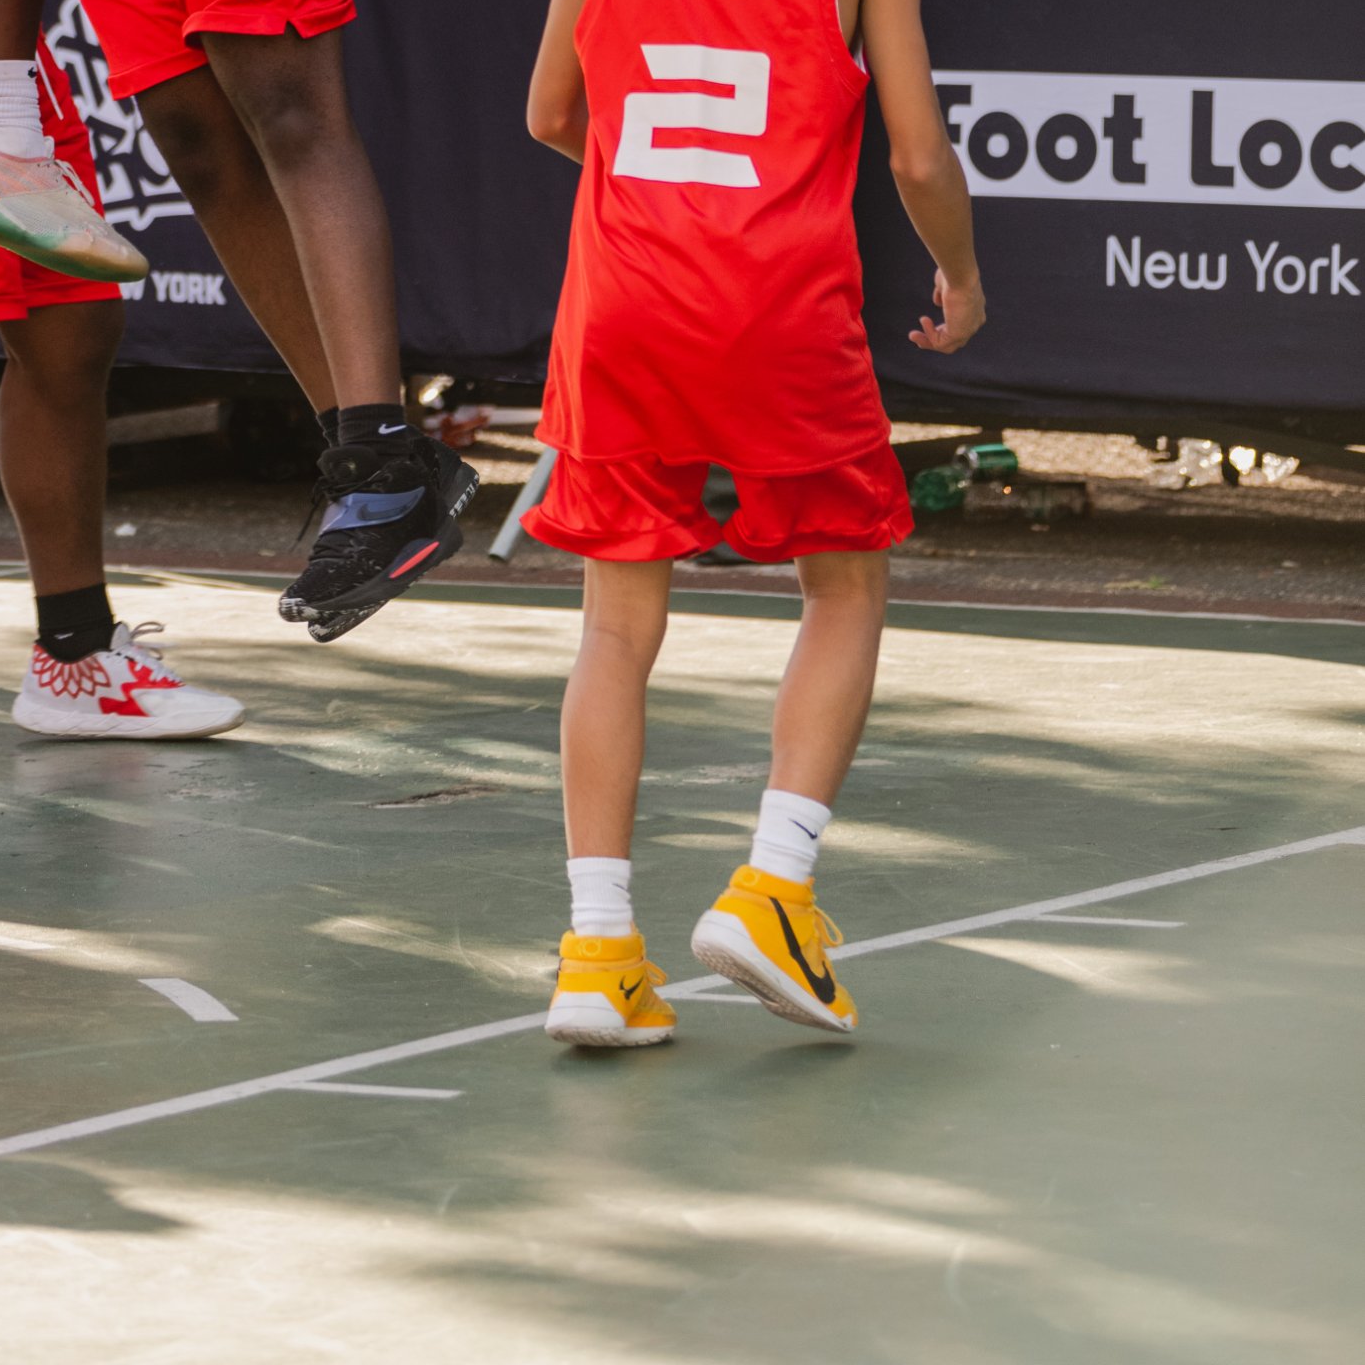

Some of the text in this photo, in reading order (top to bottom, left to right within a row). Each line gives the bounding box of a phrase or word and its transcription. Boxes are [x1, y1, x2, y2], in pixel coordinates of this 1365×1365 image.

[612, 43, 771, 188] 2
[152, 269, 227, 306] YORK
[1106, 235, 1361, 296] New York
